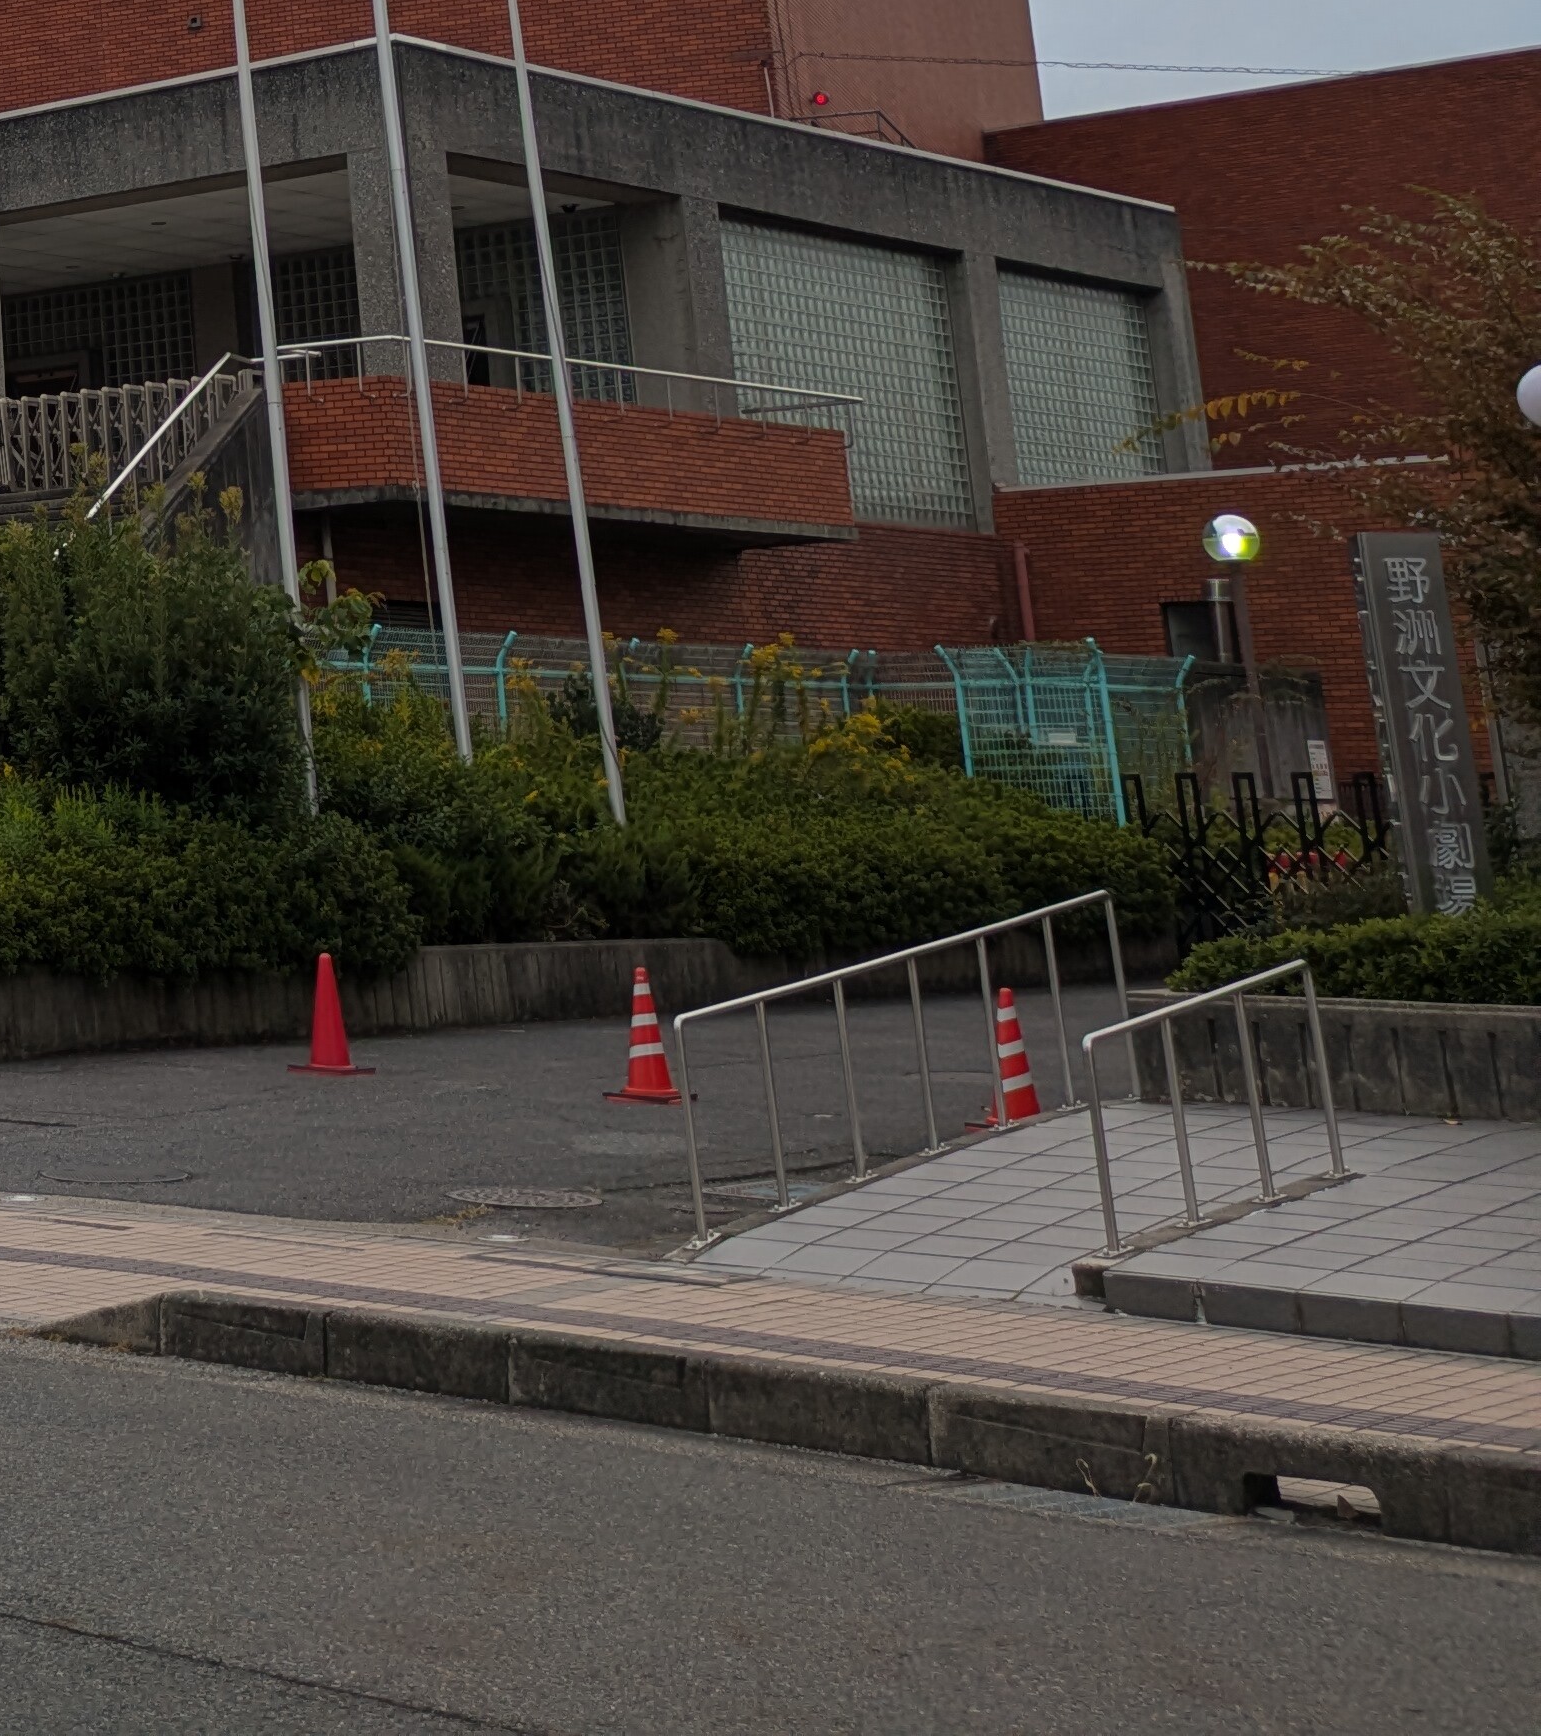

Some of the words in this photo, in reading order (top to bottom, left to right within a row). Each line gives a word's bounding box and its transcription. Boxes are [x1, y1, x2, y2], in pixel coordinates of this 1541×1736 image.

[1383, 557, 1477, 915] 野洲文化小劇場
